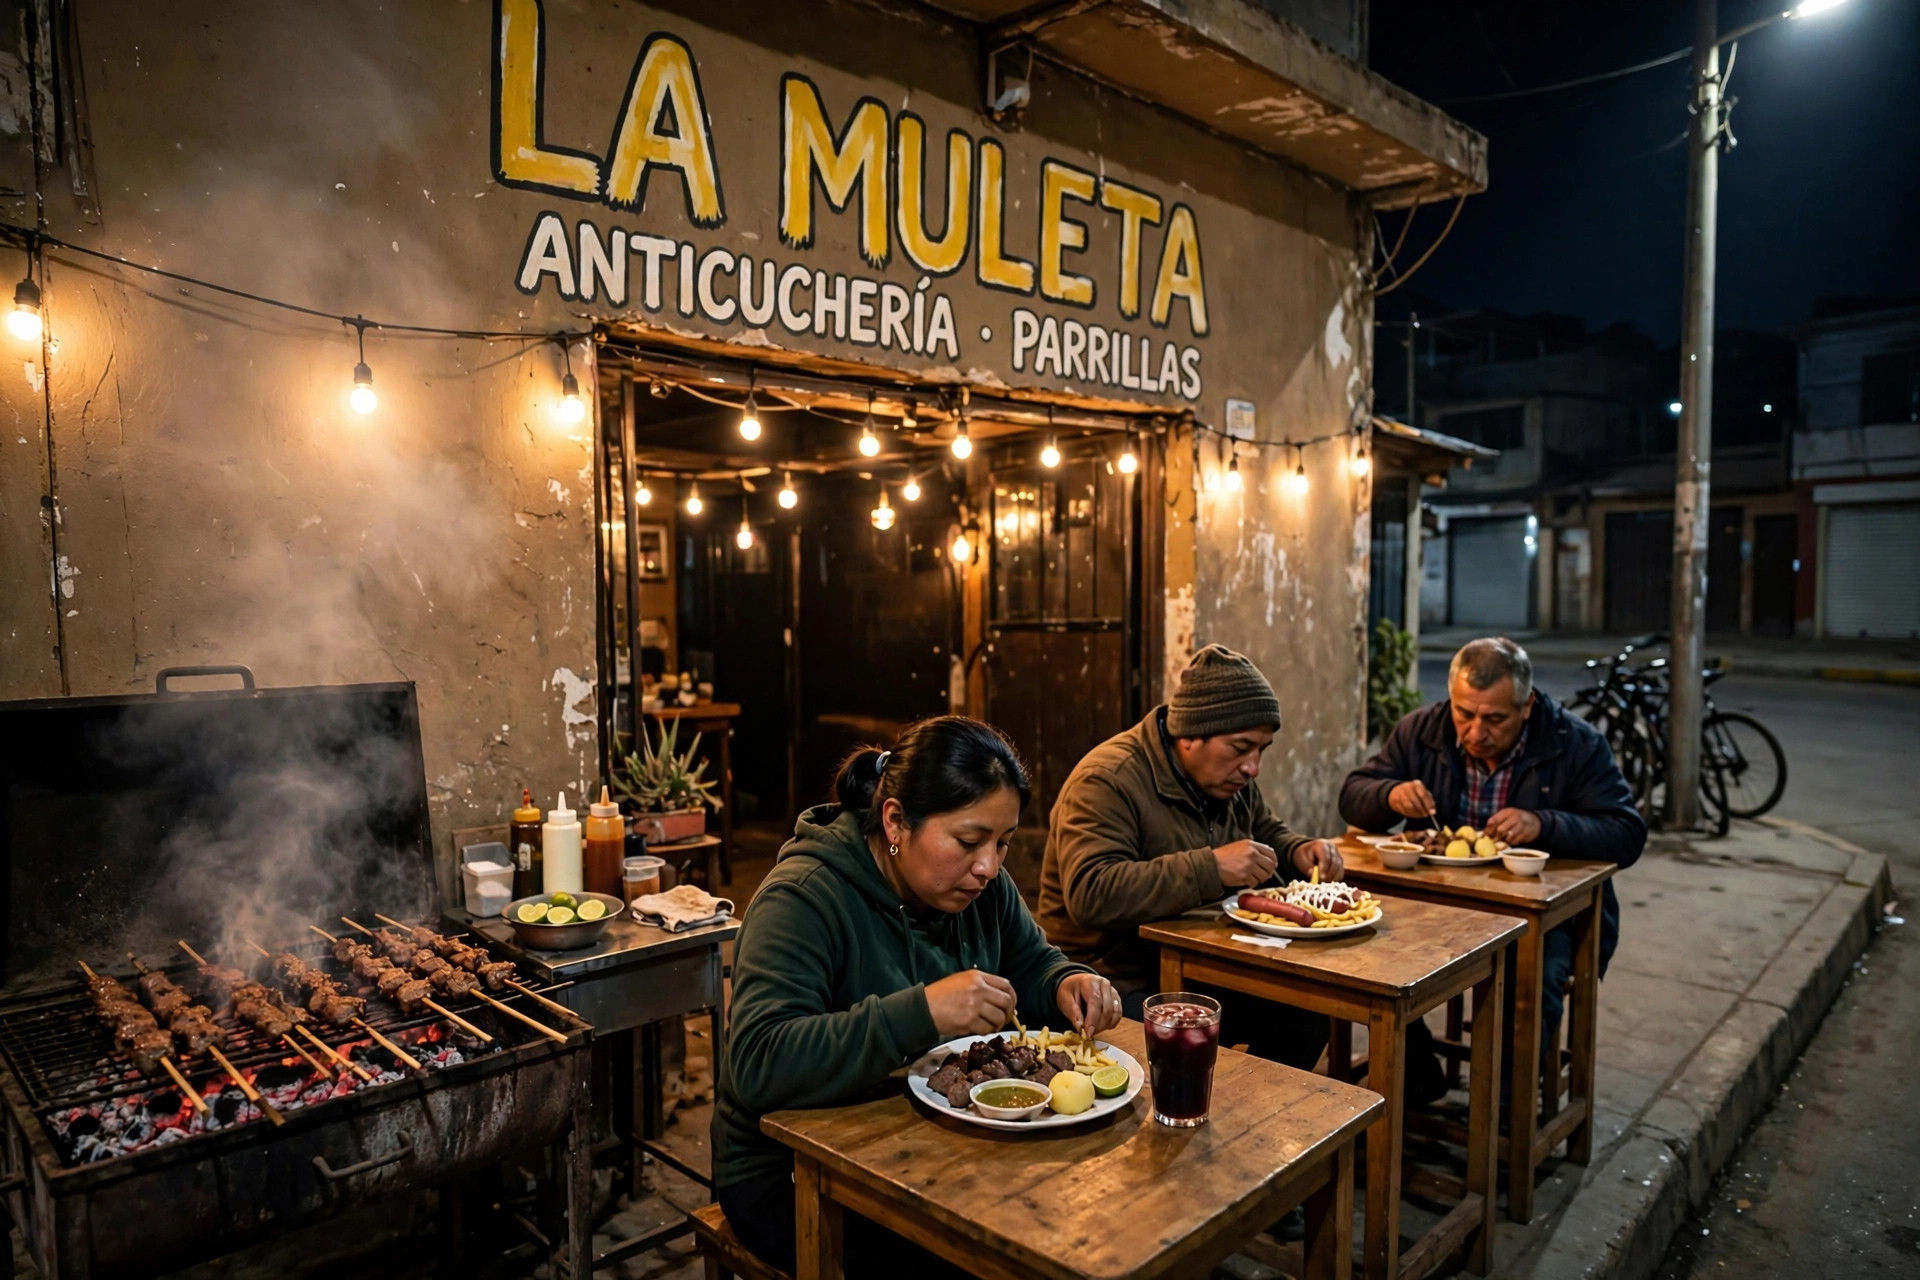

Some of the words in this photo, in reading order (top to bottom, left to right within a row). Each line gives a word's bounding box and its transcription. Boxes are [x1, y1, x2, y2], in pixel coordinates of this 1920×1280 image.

[492, 0, 727, 228] LA
[779, 71, 1207, 336] MULETA
[517, 212, 958, 359] ANTICUCHERÍA
[1012, 309, 1203, 401] PARRILLAS
